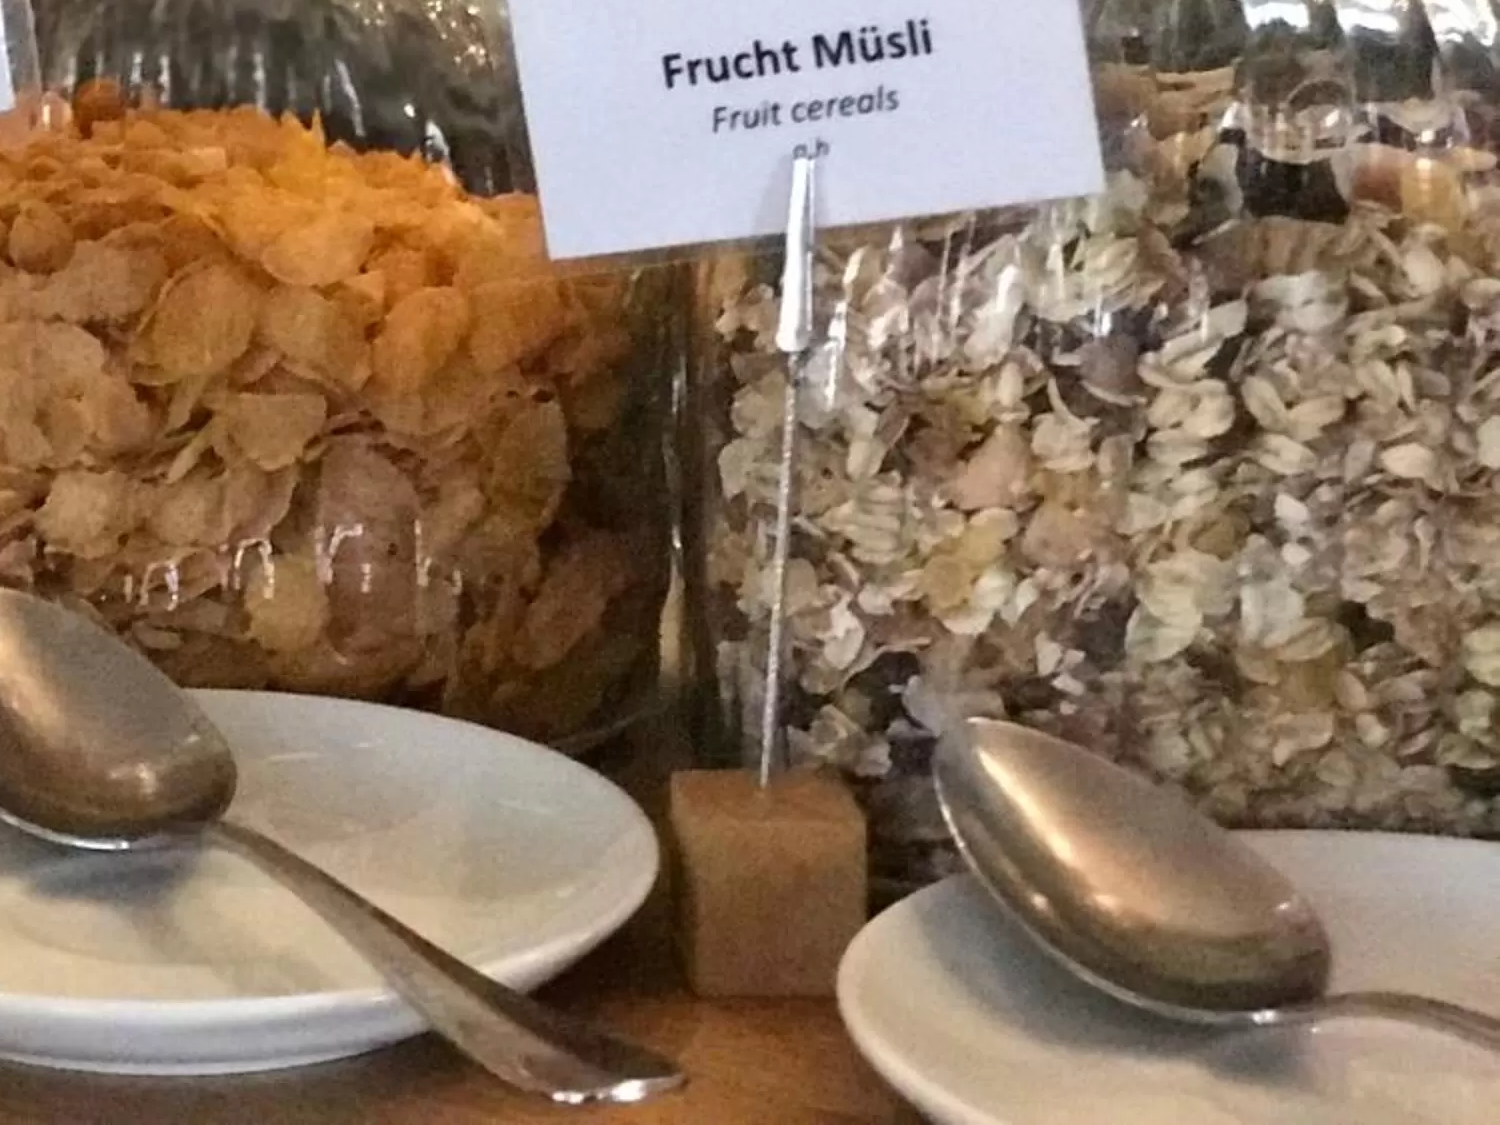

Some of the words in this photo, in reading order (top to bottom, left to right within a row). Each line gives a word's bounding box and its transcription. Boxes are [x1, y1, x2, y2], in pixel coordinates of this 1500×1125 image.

[662, 38, 800, 90] Frucht
[812, 18, 934, 70] Müsli
[712, 102, 782, 134] Fruit
[790, 84, 900, 124] cereals
